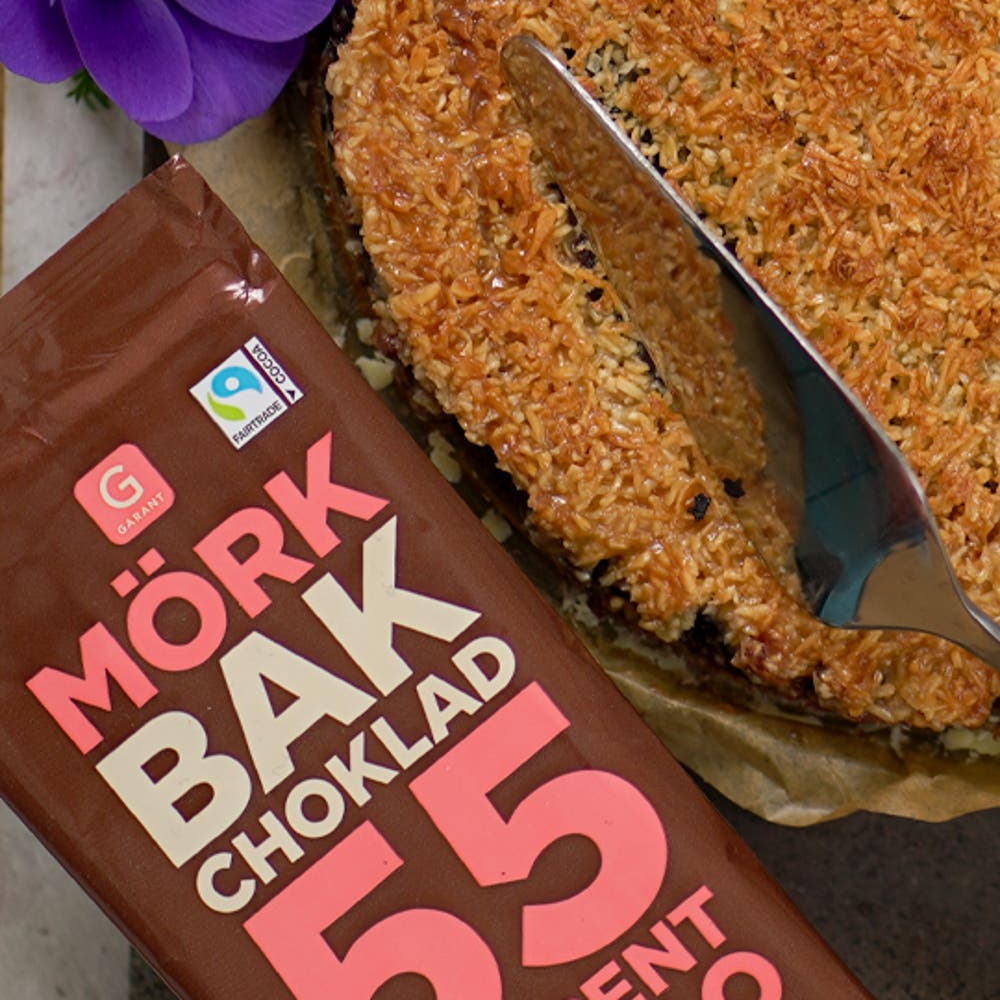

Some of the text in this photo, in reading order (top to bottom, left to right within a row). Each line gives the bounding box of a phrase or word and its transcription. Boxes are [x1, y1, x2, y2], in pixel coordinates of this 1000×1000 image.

[251, 344, 286, 384] COCOA
[232, 400, 282, 444] FAIRTRADE
[99, 464, 144, 509] G
[117, 492, 165, 535] GARANT
[26, 430, 391, 755] MÖRK
[95, 515, 482, 868] BAK
[197, 635, 517, 913] CHOKLAD
[242, 681, 668, 1000] 55
[568, 885, 727, 1000] ENT
